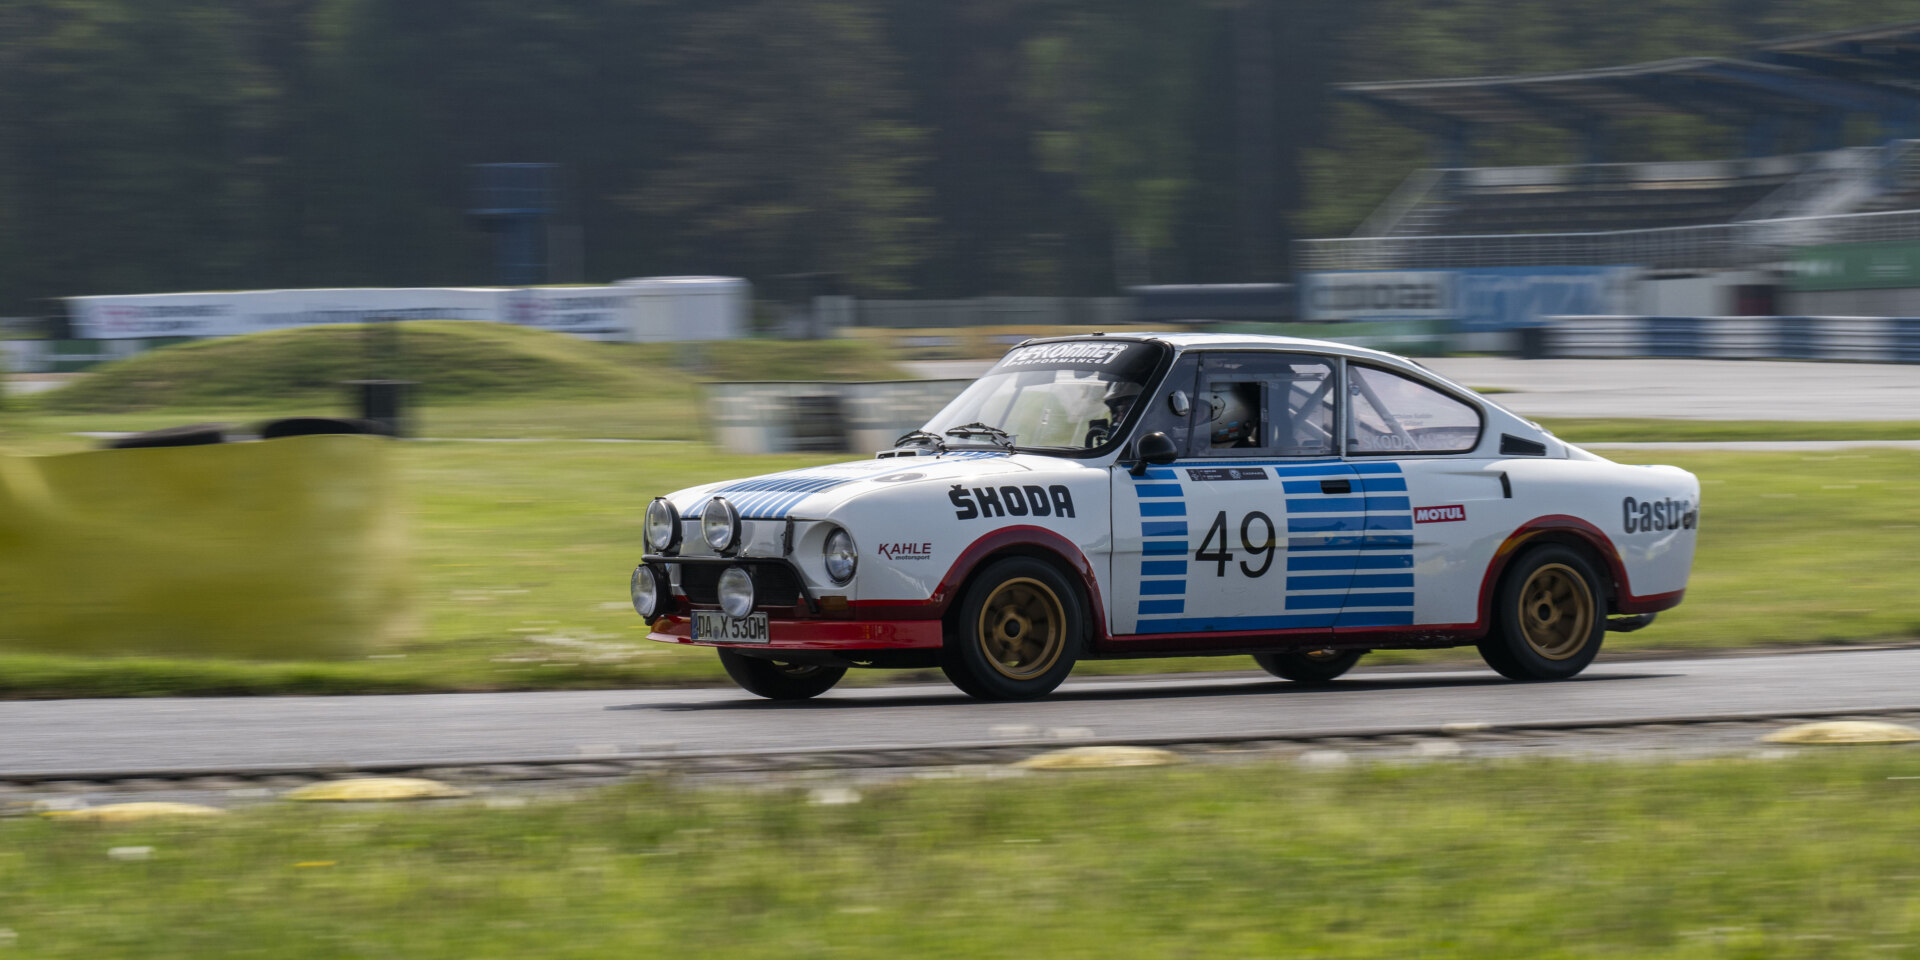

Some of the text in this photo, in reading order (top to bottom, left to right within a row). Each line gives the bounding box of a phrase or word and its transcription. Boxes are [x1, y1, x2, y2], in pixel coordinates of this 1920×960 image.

[1009, 358, 1103, 367] PERFORMANCE
[948, 484, 1076, 521] ŠKODA
[1416, 507, 1464, 521] MOTUL
[878, 543, 932, 560] KAHLE
[1194, 510, 1277, 579] 49
[698, 616, 712, 638] DA
[720, 616, 729, 638] X
